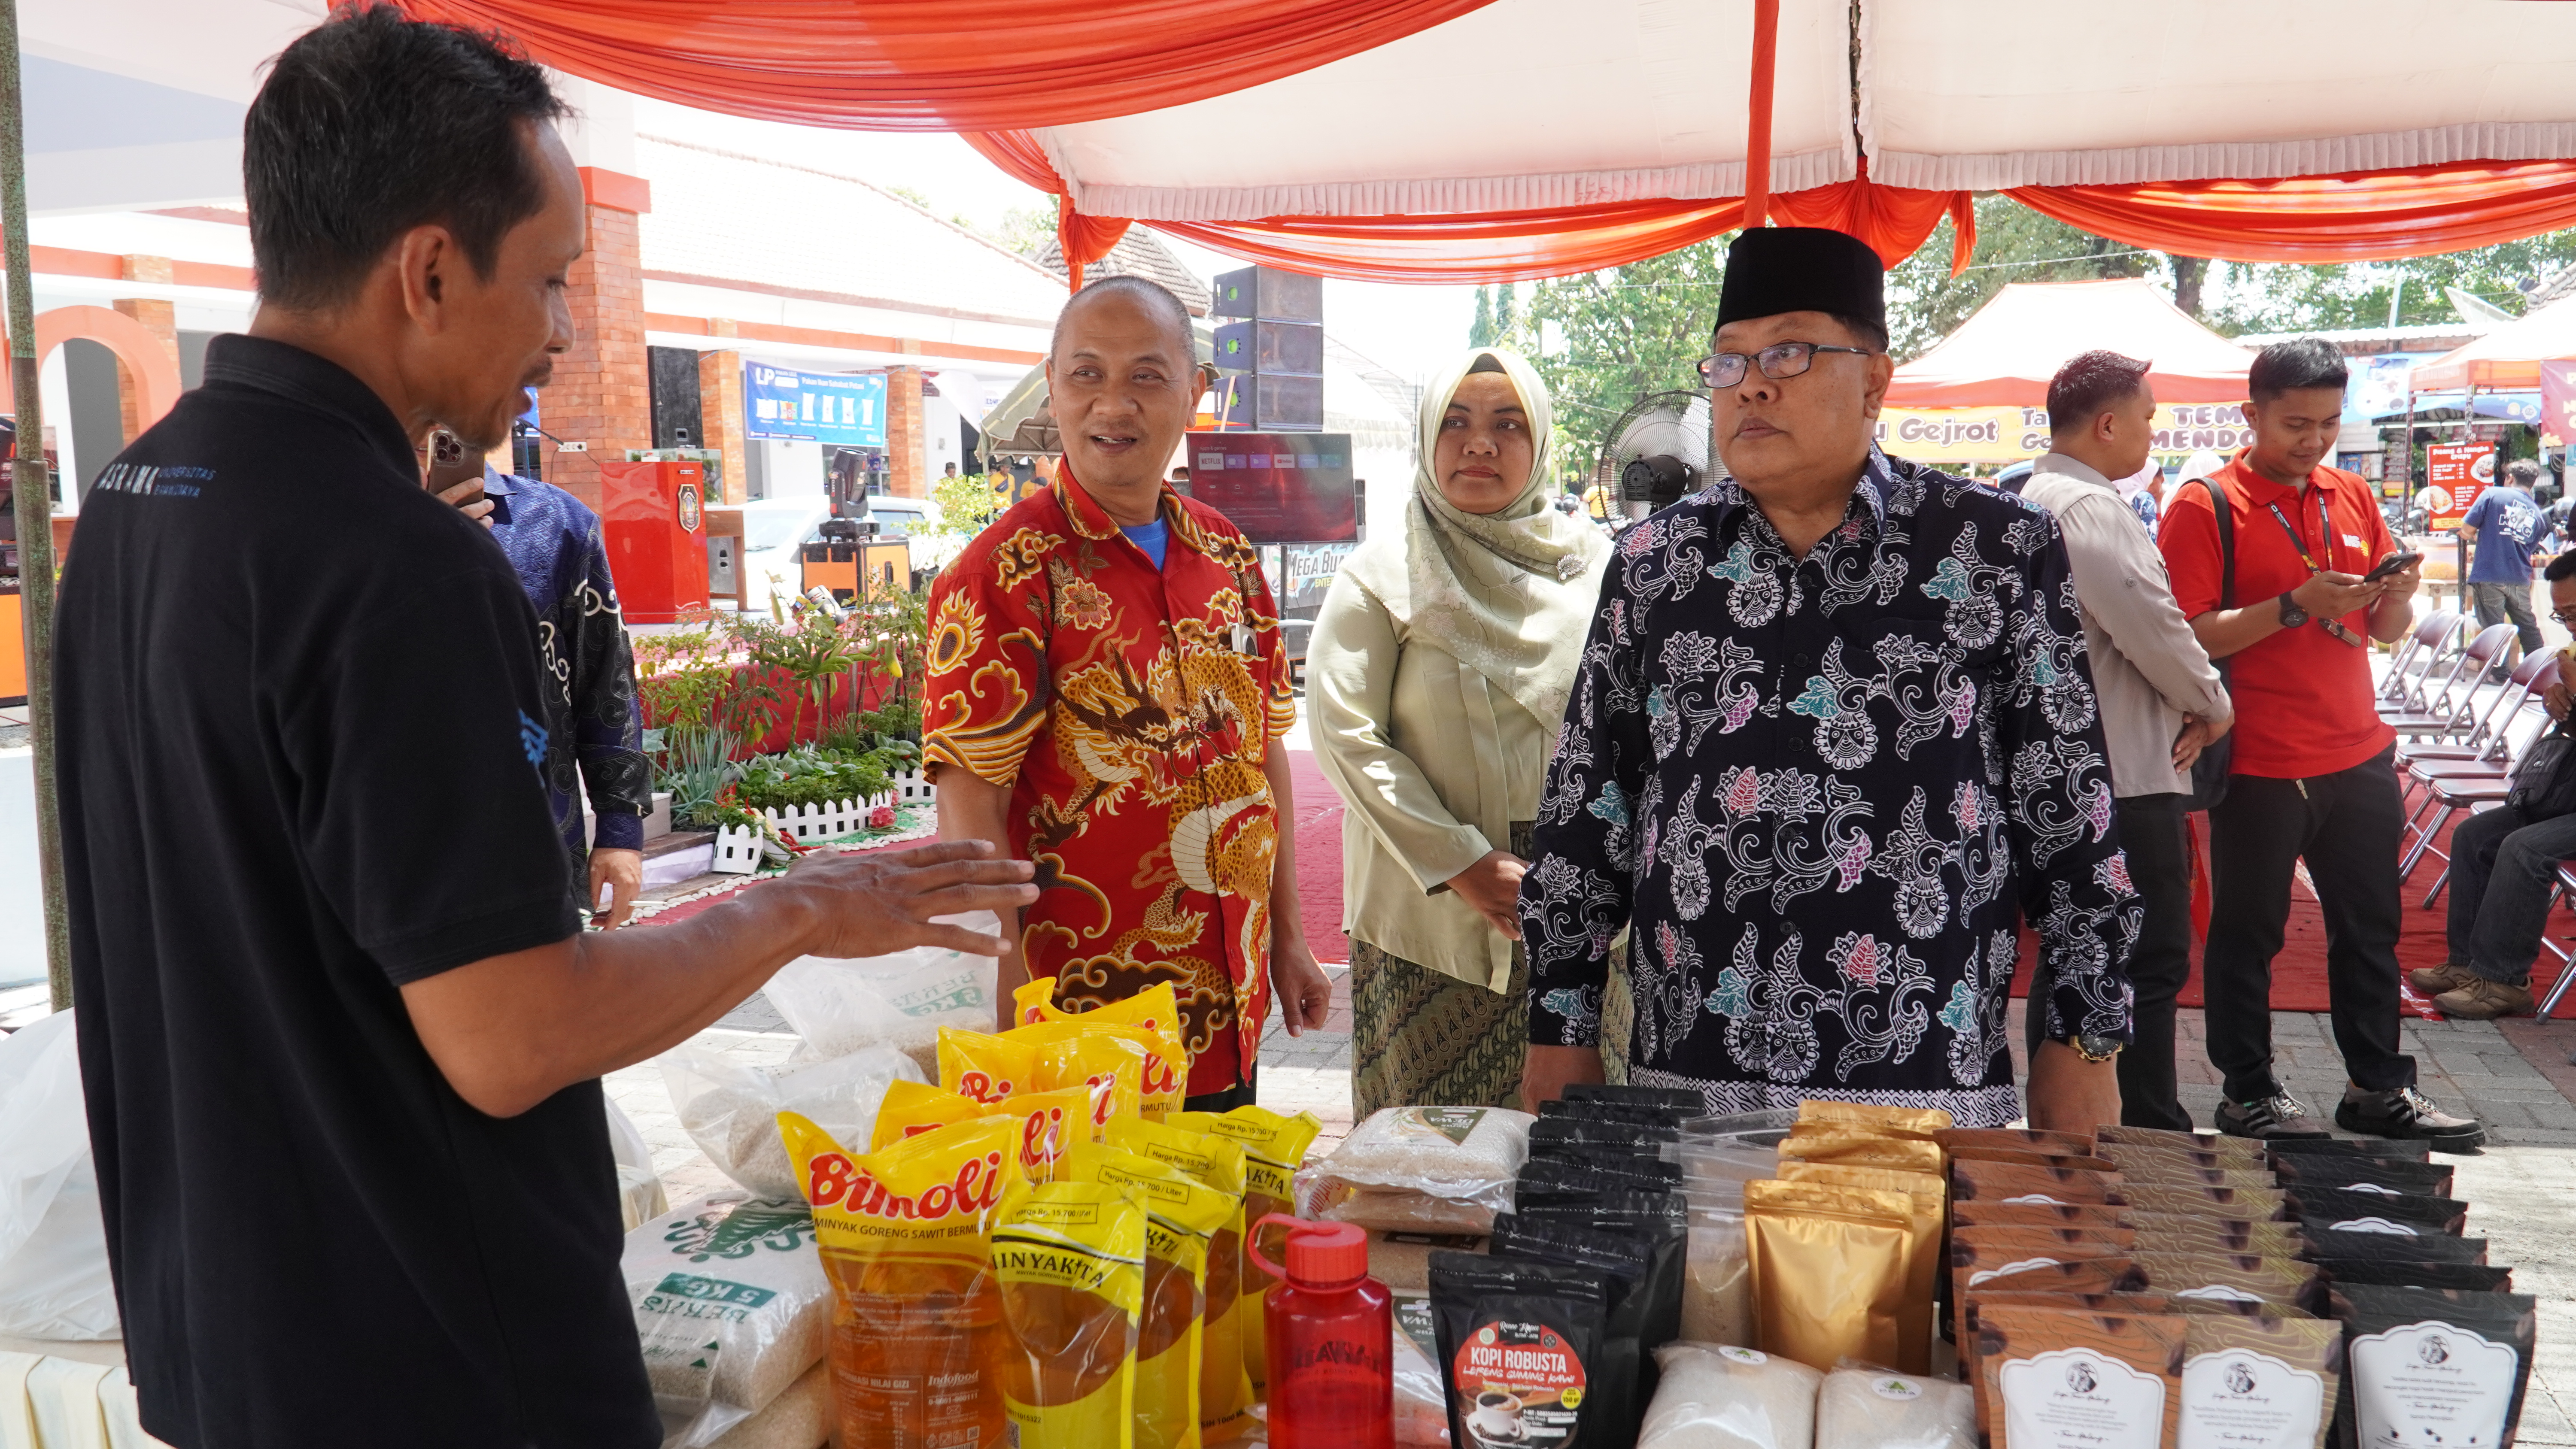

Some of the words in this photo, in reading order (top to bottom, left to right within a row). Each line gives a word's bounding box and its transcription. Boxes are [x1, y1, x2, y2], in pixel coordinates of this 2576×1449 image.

[755, 367, 775, 385] LP
[1899, 416, 1999, 446] Gejrot
[1217, 1122, 1236, 1131] Harga
[1152, 1149, 1173, 1161] Harga
[1173, 1155, 1185, 1164] Rp.
[1187, 1158, 1209, 1170] 15.700
[1105, 1170, 1123, 1183] Harga
[1124, 1177, 1135, 1186] Rp.
[1166, 1187, 1182, 1196] Liter
[1016, 1208, 1036, 1218] Harga
[1038, 1208, 1050, 1218] Rp.
[815, 1217, 858, 1234] MINYAK
[860, 1225, 908, 1238] GORENG
[911, 1228, 946, 1239] SAWIT
[992, 1252, 1104, 1288] INYAKITA
[684, 1280, 735, 1299] KG
[735, 1289, 760, 1304] 5
[1470, 1346, 1501, 1367] KOPI
[1505, 1349, 1567, 1373] ROBUSTA
[893, 1379, 910, 1388] GIZI
[928, 1369, 979, 1387] Indofood
[1463, 1365, 1504, 1378] LERENG
[1506, 1370, 1545, 1382] GUNUNG
[1548, 1373, 1576, 1384] KAWI
